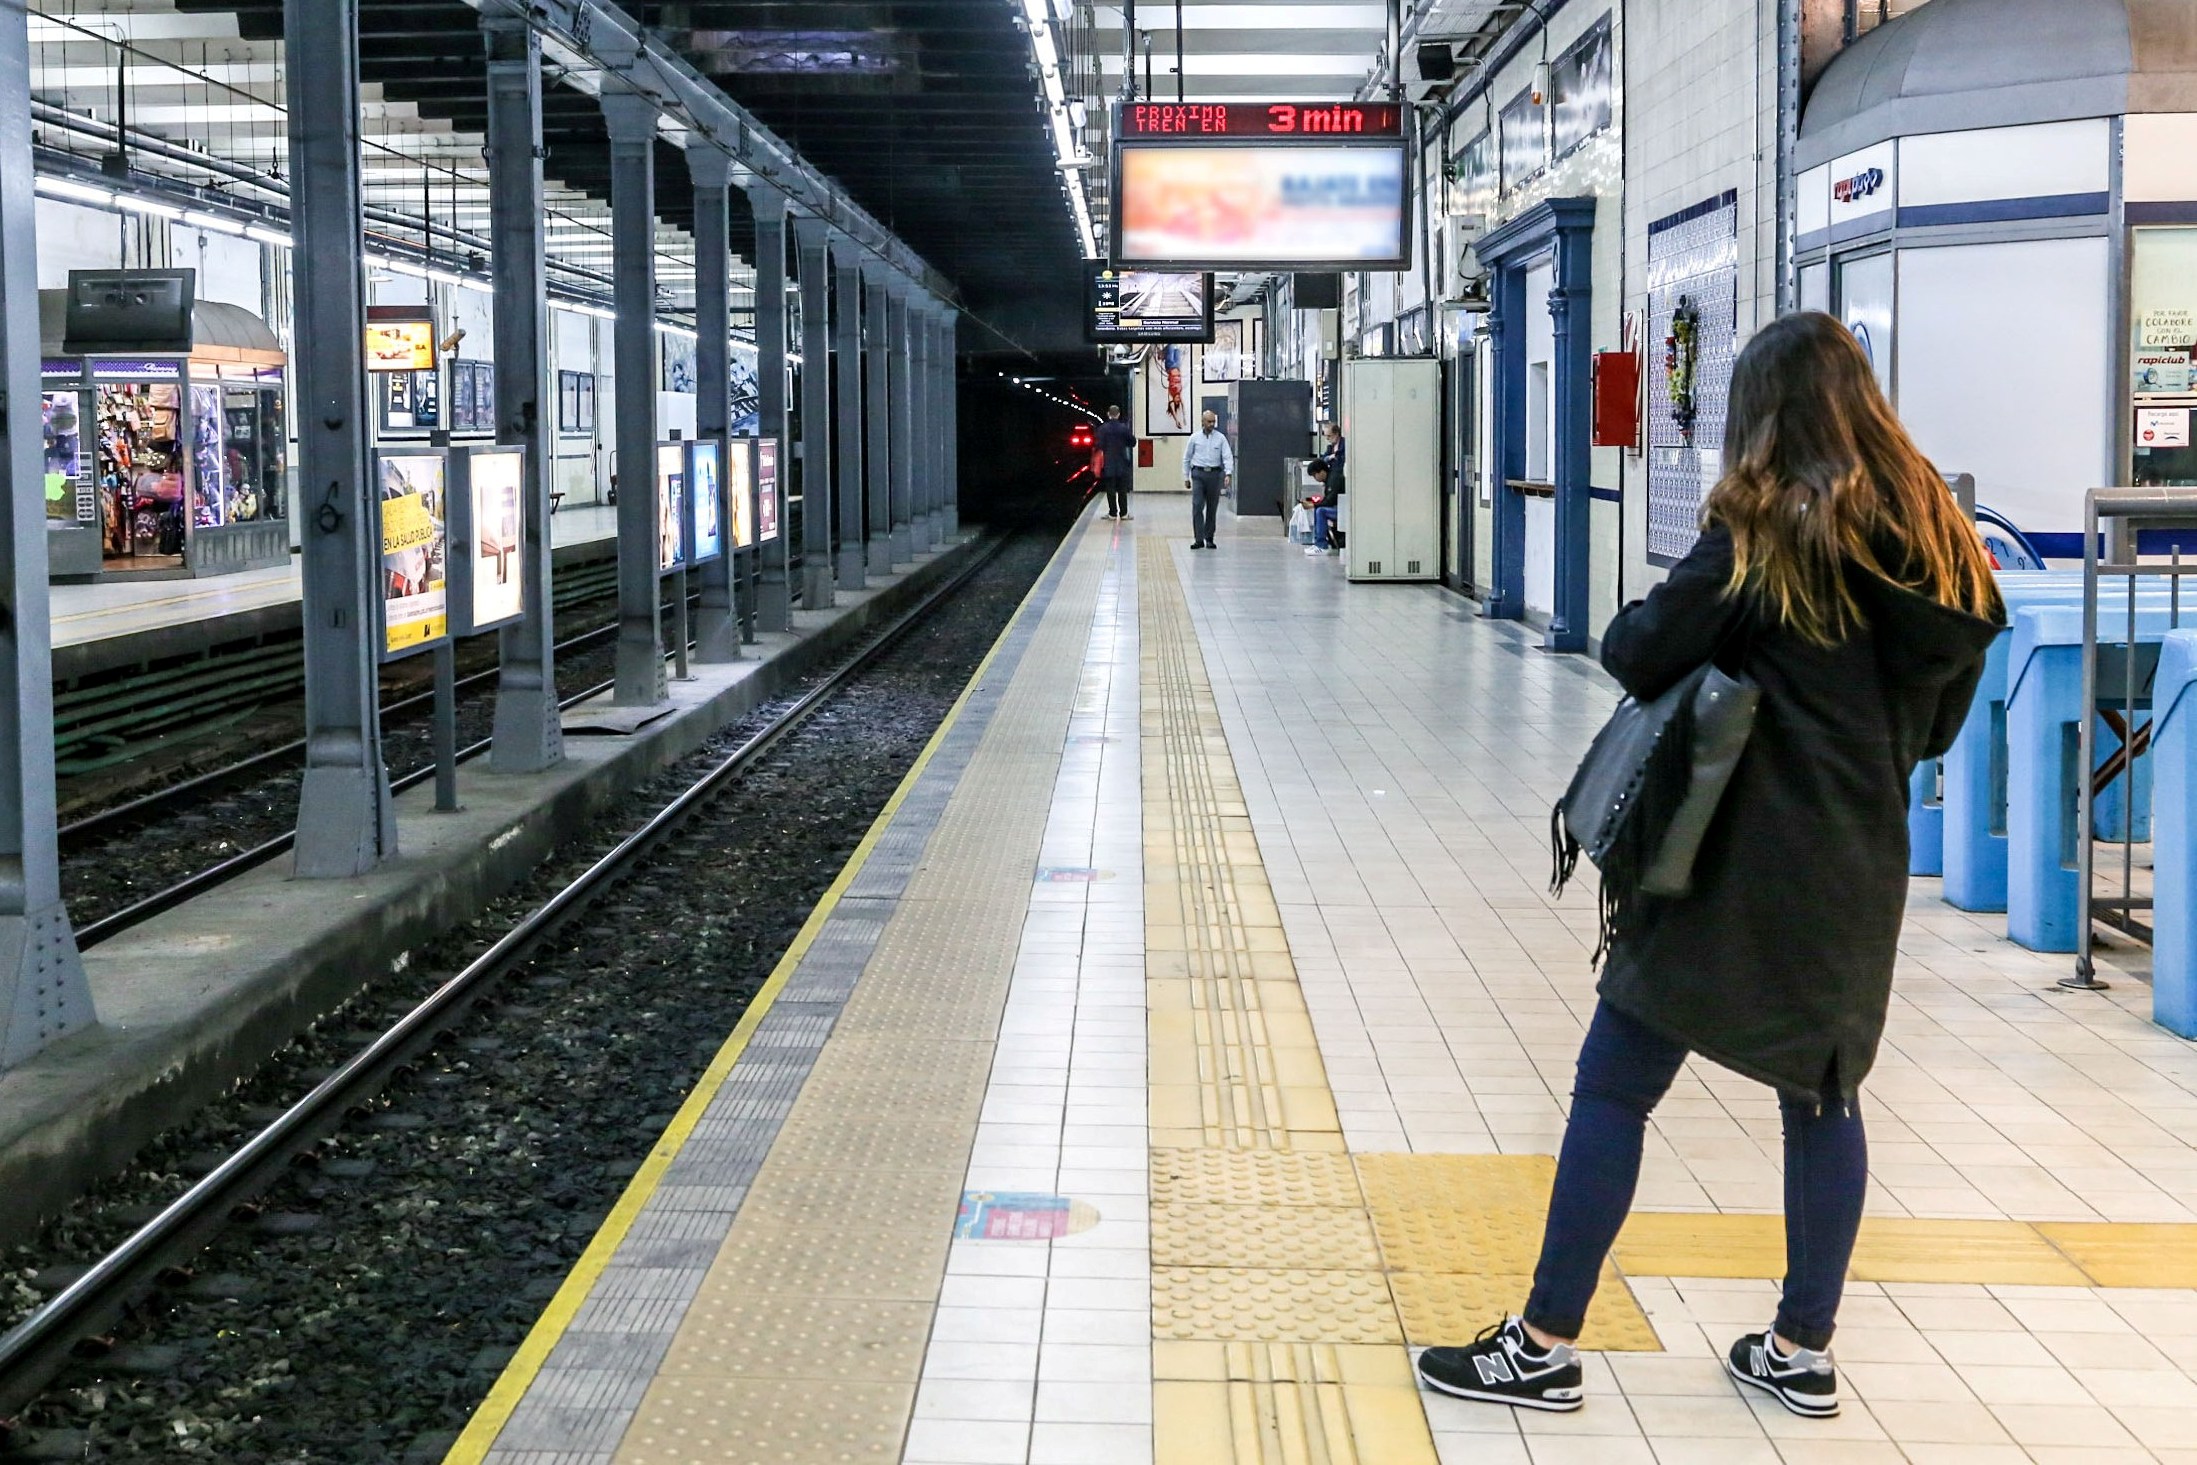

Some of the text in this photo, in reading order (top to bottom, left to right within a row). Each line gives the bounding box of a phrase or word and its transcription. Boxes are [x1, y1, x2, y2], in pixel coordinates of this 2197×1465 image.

[1136, 105, 1226, 119] PROXIMO
[1267, 105, 1363, 132] 3 min
[1136, 118, 1226, 132] TREN EN
[2145, 318, 2193, 327] COLABORE
[2146, 335, 2191, 344] CAMBIO
[2137, 356, 2186, 365] rapiclub
[1749, 1345, 1768, 1377] N
[1472, 1351, 1515, 1386] N
